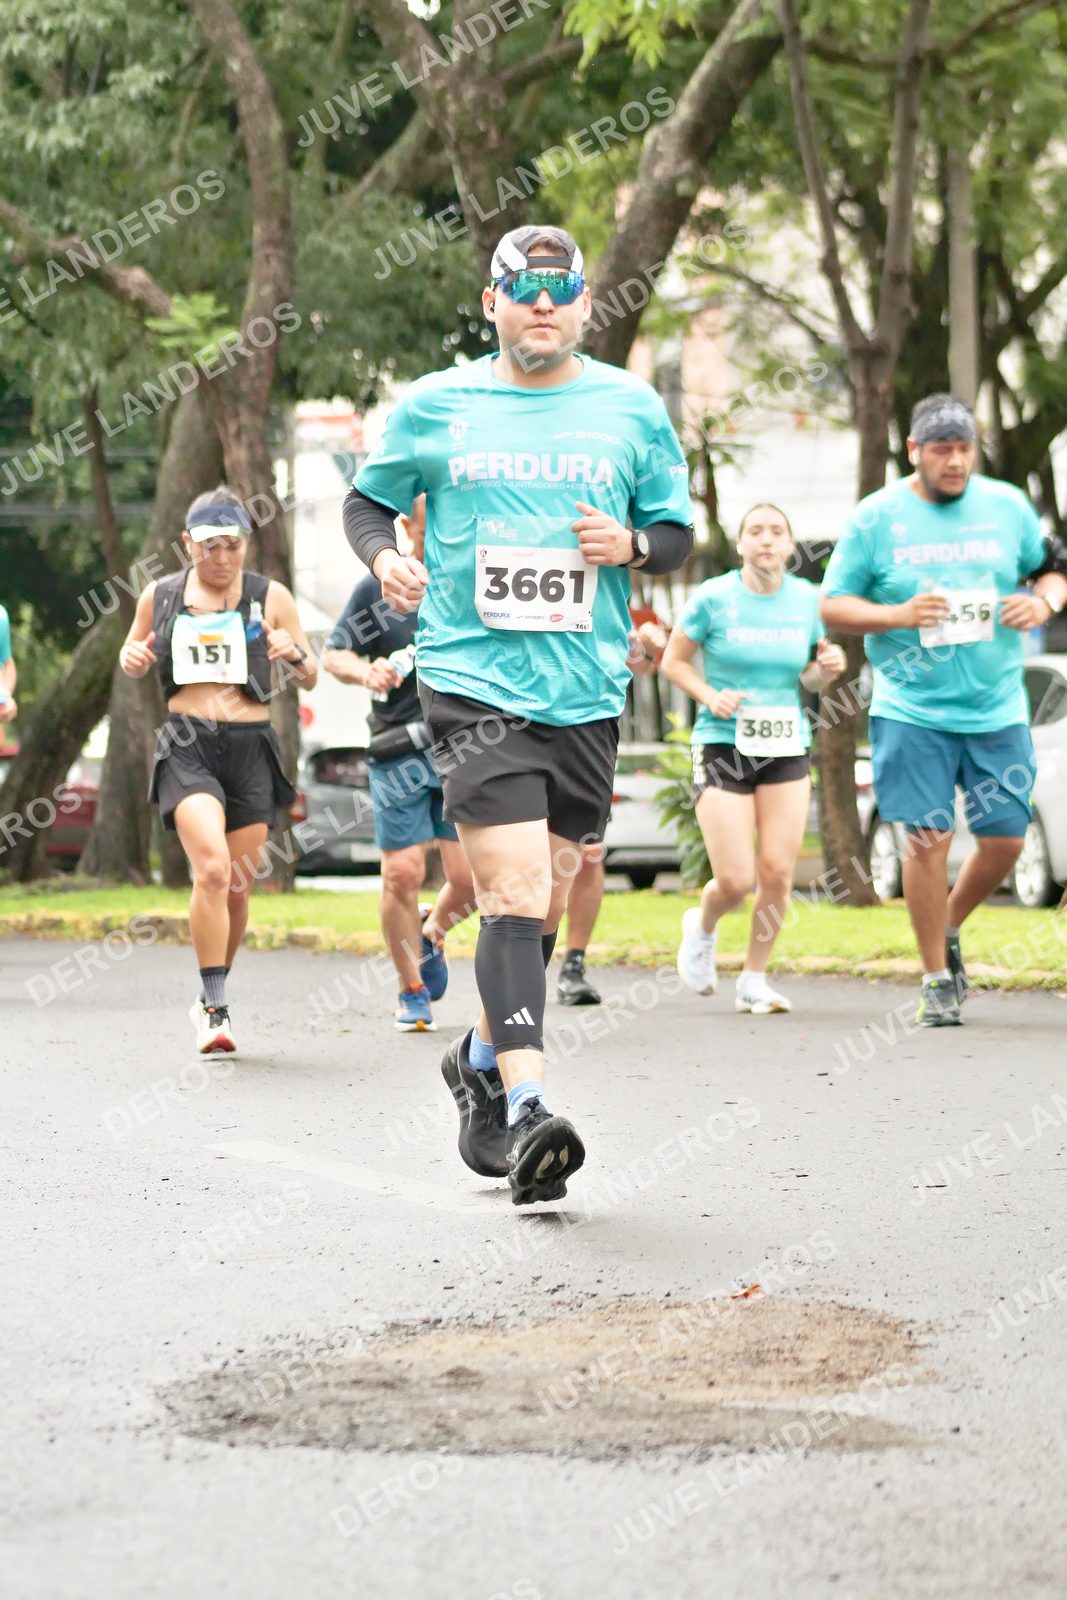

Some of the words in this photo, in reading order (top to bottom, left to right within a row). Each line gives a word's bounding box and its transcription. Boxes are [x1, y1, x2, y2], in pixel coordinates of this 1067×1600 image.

[448, 451, 613, 488] PERDURA
[484, 567, 585, 604] 3661
[188, 644, 231, 664] 151
[742, 719, 793, 738] 3893
